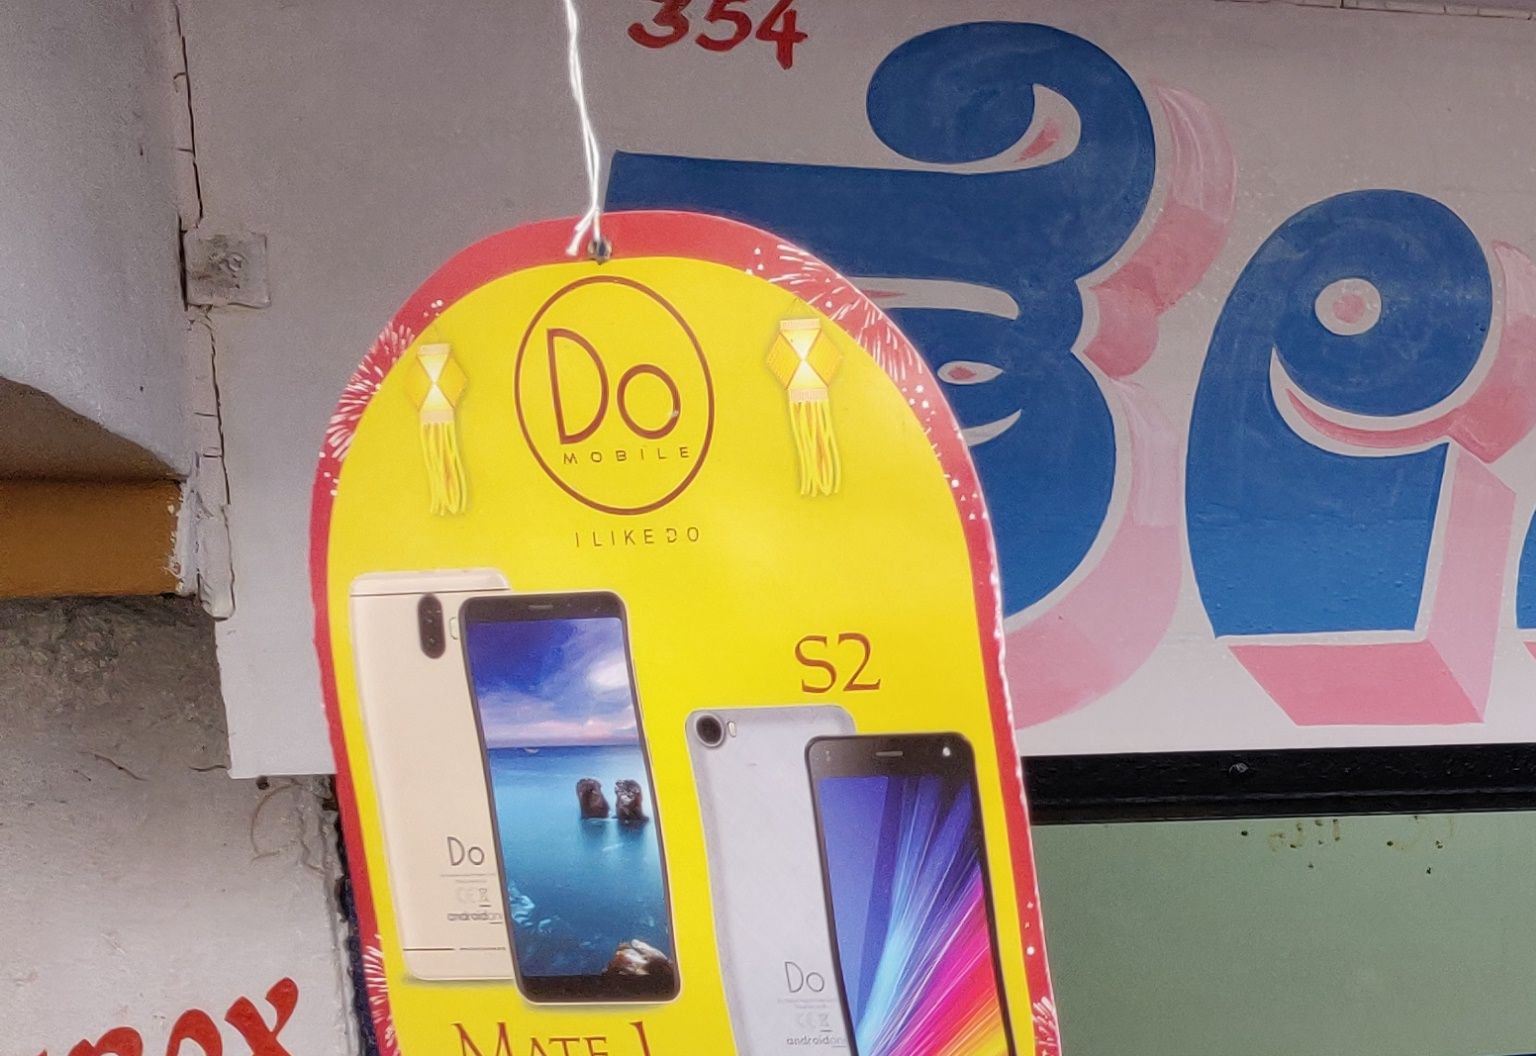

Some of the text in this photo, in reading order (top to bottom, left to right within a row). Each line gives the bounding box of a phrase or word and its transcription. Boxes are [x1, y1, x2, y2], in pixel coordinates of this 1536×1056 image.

[627, 0, 808, 70] 354
[546, 327, 681, 445] Do
[563, 446, 692, 465] MOBILE
[793, 632, 882, 694] S2
[447, 836, 485, 866] Do
[785, 961, 825, 993] Do
